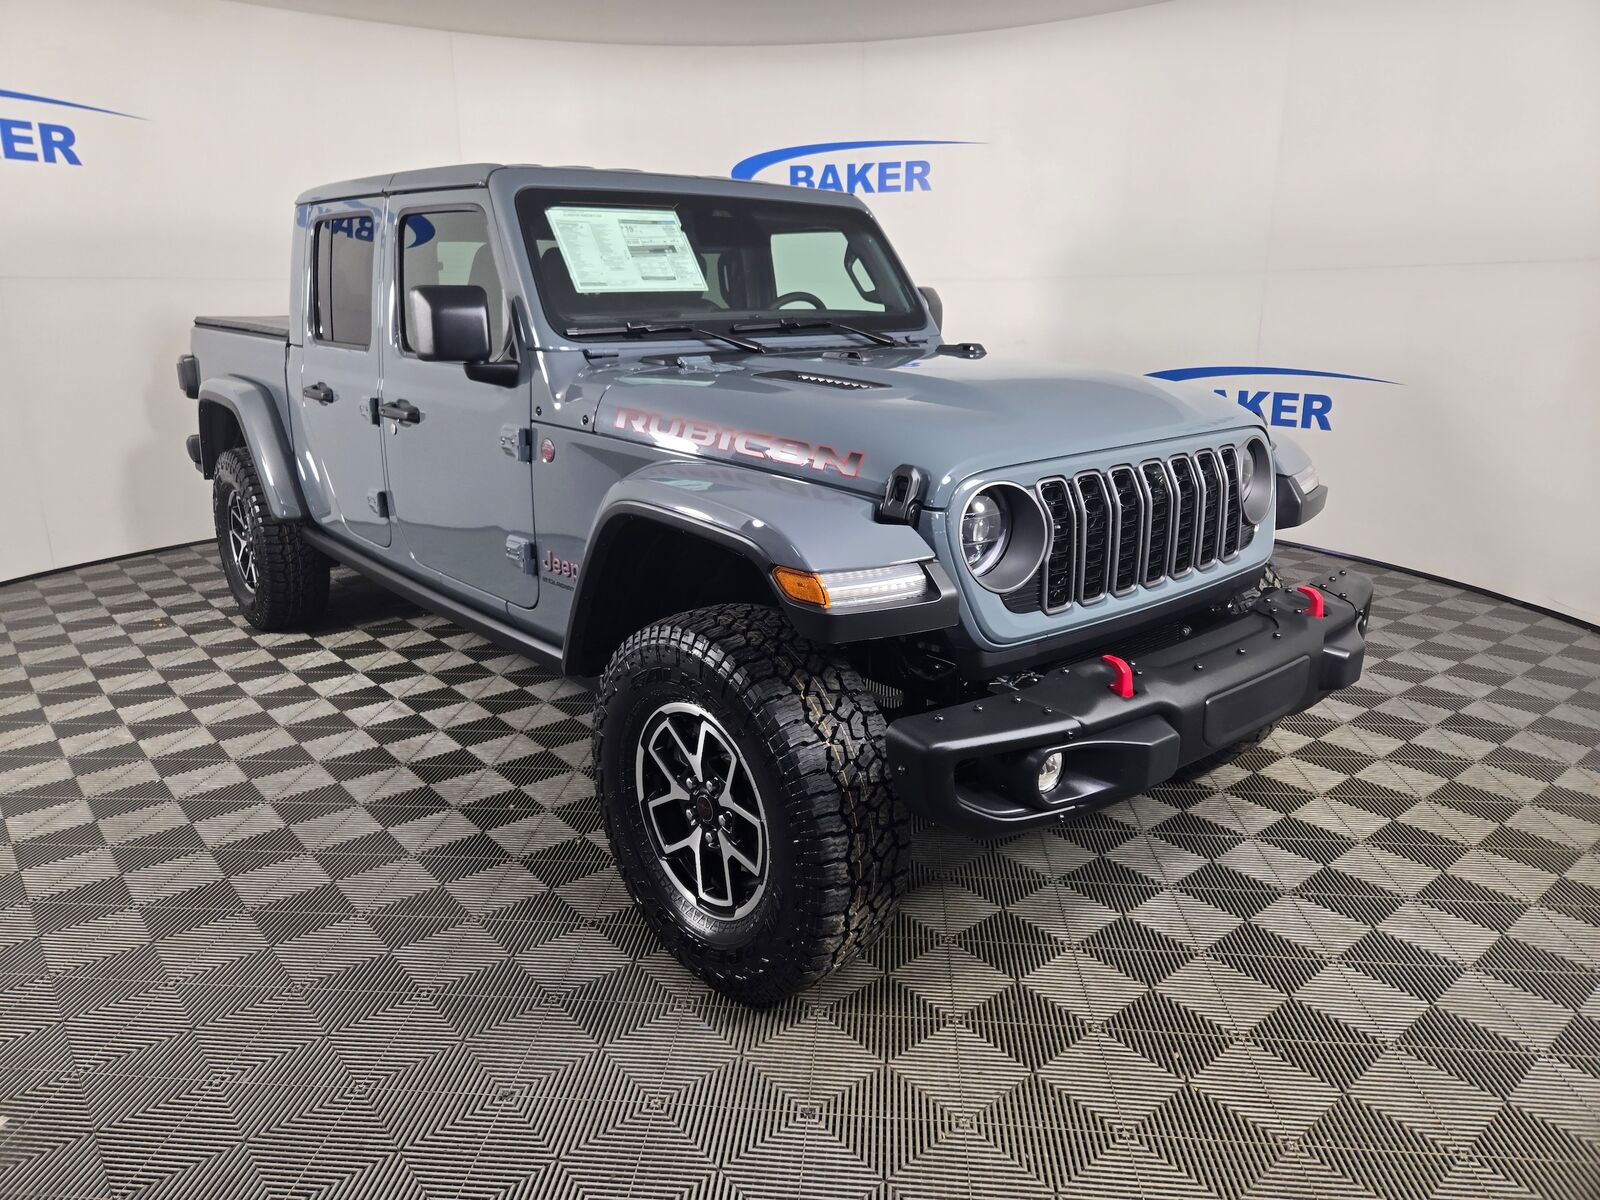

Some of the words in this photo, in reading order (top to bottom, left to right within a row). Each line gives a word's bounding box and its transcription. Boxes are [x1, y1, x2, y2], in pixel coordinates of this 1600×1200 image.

[0, 118, 82, 166] ER
[789, 160, 932, 195] BAKER
[1213, 389, 1332, 432] KER
[614, 406, 865, 478] RUBICON
[542, 550, 580, 586] Jeep
